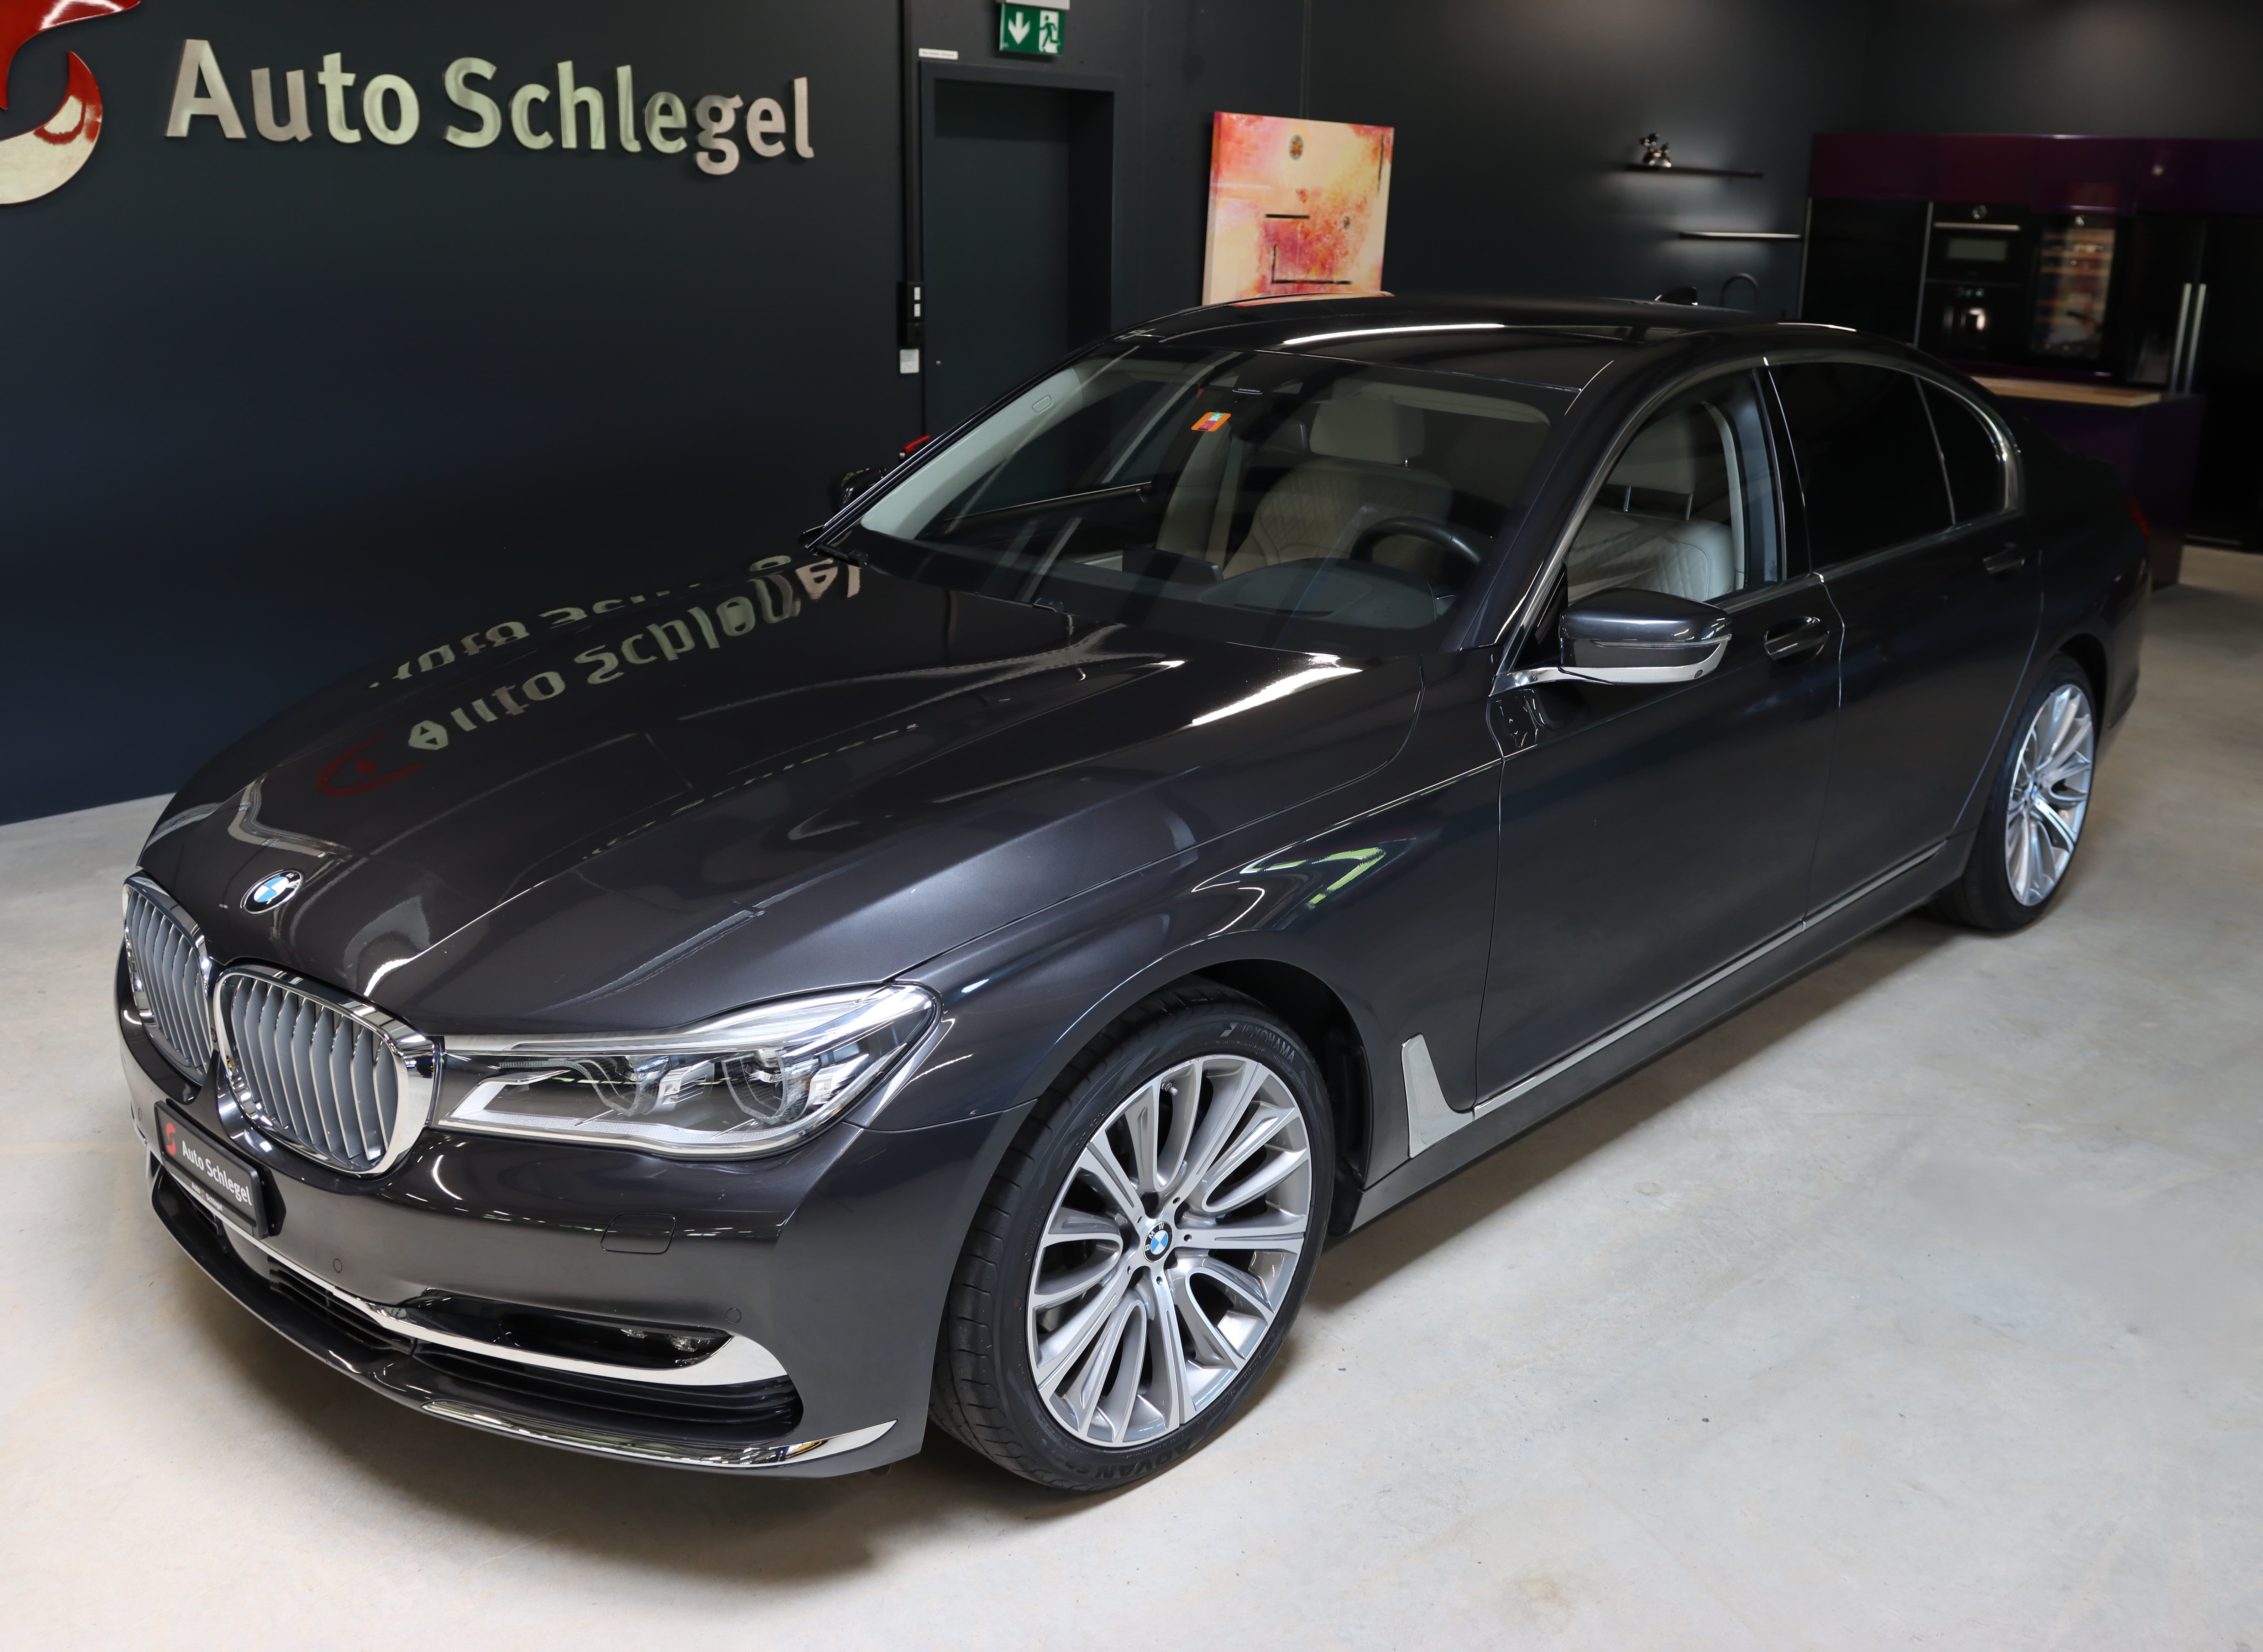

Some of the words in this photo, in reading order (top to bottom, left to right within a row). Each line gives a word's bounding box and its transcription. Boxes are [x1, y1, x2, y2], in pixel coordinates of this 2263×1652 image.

[165, 37, 421, 147] Auto
[444, 56, 815, 176] Schlegel
[182, 1140, 205, 1171] Auto
[205, 1158, 252, 1206] Schlegel
[191, 1181, 201, 1194] Auto
[206, 1193, 223, 1211] Schlegel
[1145, 1223, 1164, 1252] BMW
[1095, 1436, 1194, 1480] ADVAN
